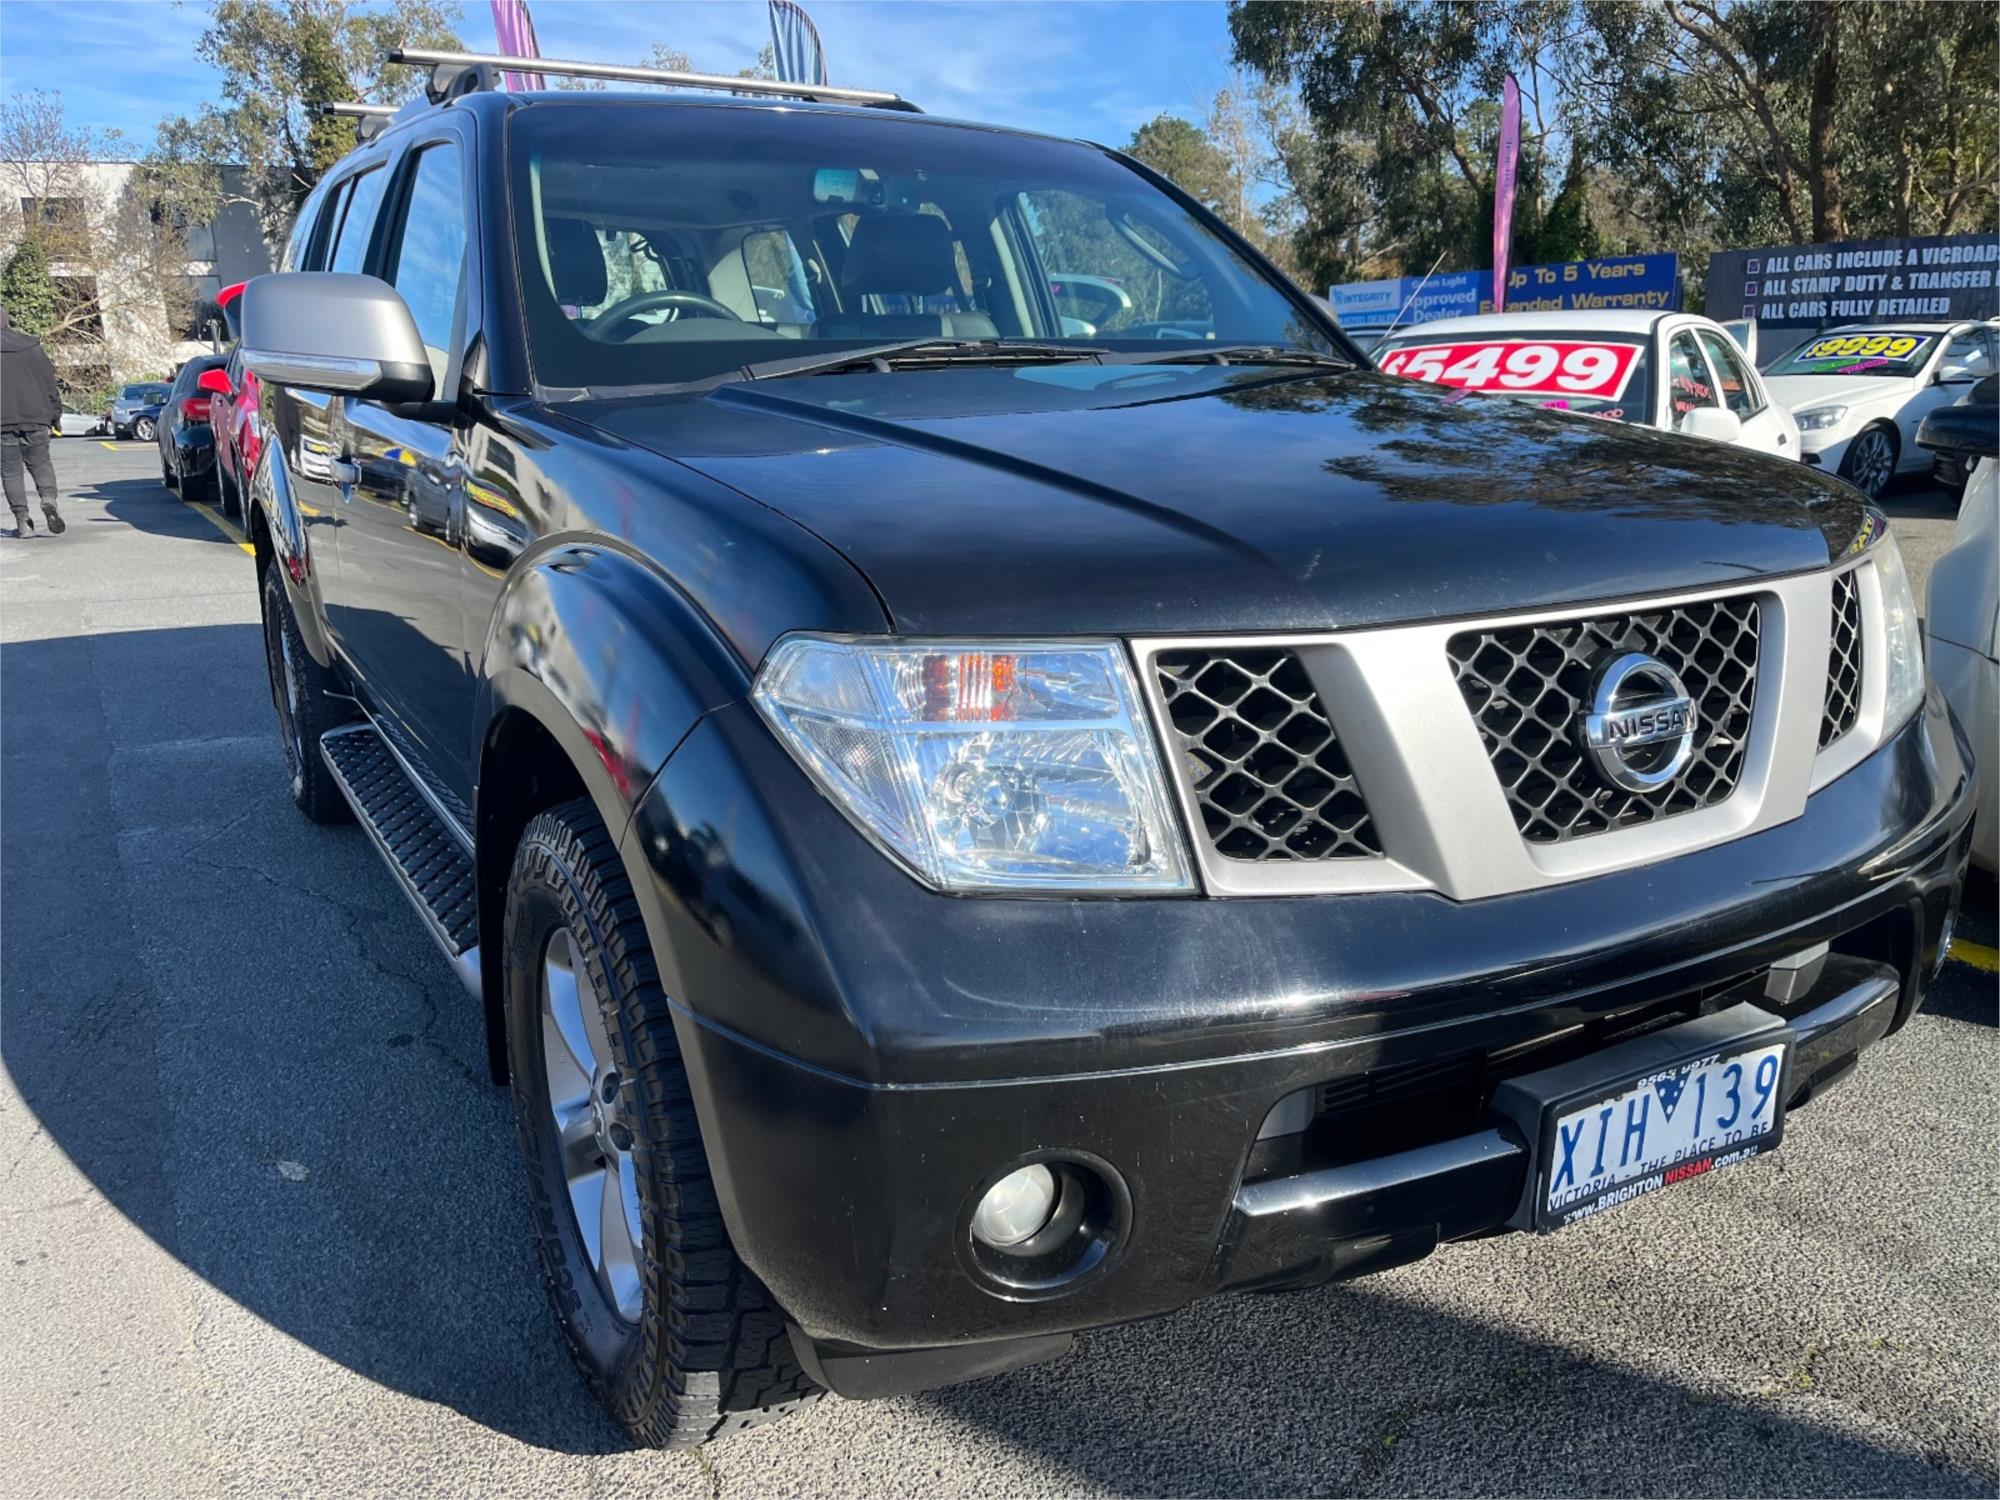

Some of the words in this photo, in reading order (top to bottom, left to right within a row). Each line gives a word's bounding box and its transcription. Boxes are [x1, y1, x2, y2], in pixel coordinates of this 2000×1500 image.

[1766, 256, 1789, 274] ALL
[1793, 253, 1833, 272] CARS
[1835, 249, 1904, 269] INCLUDE
[1905, 248, 1918, 266] A
[1442, 275, 1467, 288] Light
[1534, 267, 1556, 285] To
[1564, 265, 1578, 282] 5
[1587, 262, 1646, 280] Years
[1763, 279, 1787, 296] ALL
[1791, 275, 1841, 295] STAMP
[1844, 273, 1888, 293] DUTY
[1890, 274, 1904, 290] &
[1909, 270, 1992, 290] TRANSFER
[1403, 287, 1477, 309] Approved
[1571, 290, 1669, 309] Warranty
[1761, 302, 1785, 320] ALL
[1788, 300, 1828, 318] CARS
[1831, 299, 1874, 317] FULLY
[1877, 297, 1950, 316] DETAILED
[1413, 307, 1463, 322] Dealer
[1805, 335, 1917, 358] $9999
[1384, 345, 1619, 391] $5499
[1608, 705, 1697, 738] NISSAN
[1551, 1094, 1650, 1193] XIH
[1692, 1054, 1778, 1139] 139
[1549, 1174, 1616, 1210] VICTORIA
[1640, 1155, 1667, 1174] THE
[1674, 1137, 1716, 1161] PLACE
[1724, 1129, 1742, 1146] TO
[1751, 1121, 1768, 1137] BE
